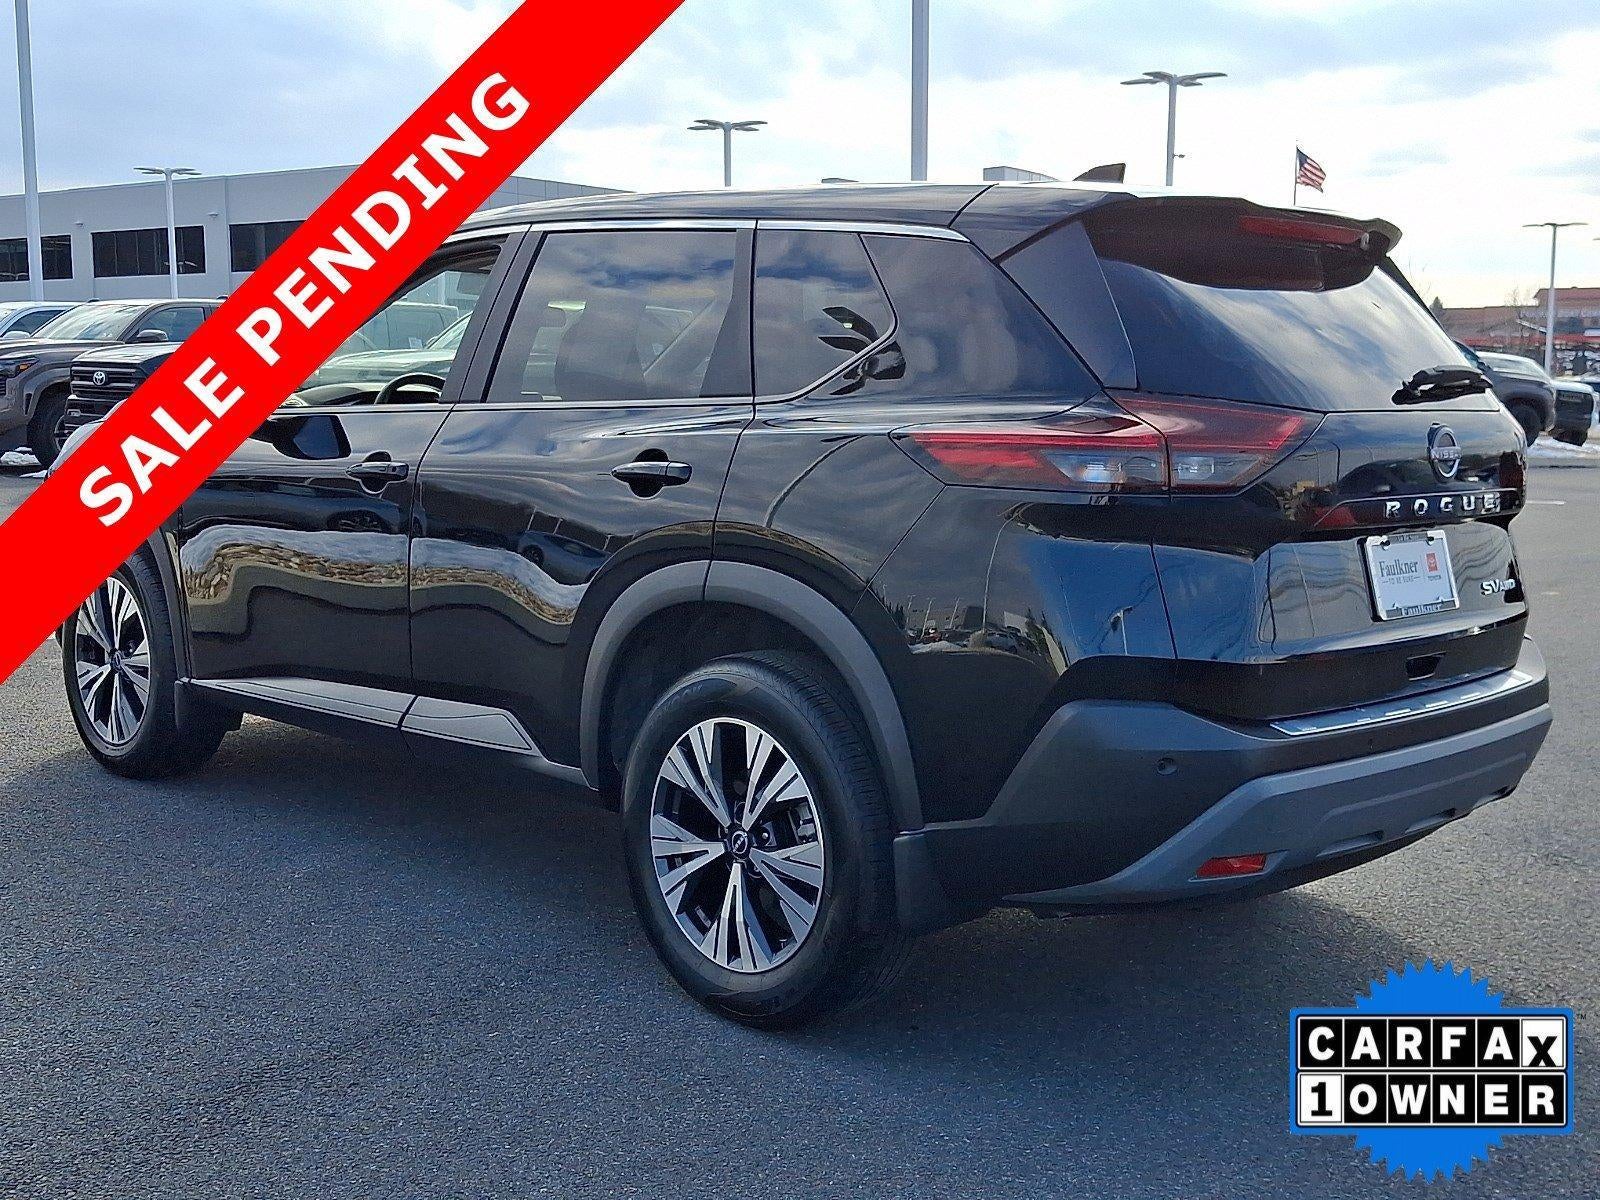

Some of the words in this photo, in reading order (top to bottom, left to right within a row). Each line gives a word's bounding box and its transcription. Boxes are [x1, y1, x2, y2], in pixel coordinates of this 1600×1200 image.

[1386, 494, 1499, 519] ROGUE
[1379, 559, 1418, 577] Faulkner
[1482, 578, 1499, 595] SV
[1401, 603, 1442, 617] Faulkner
